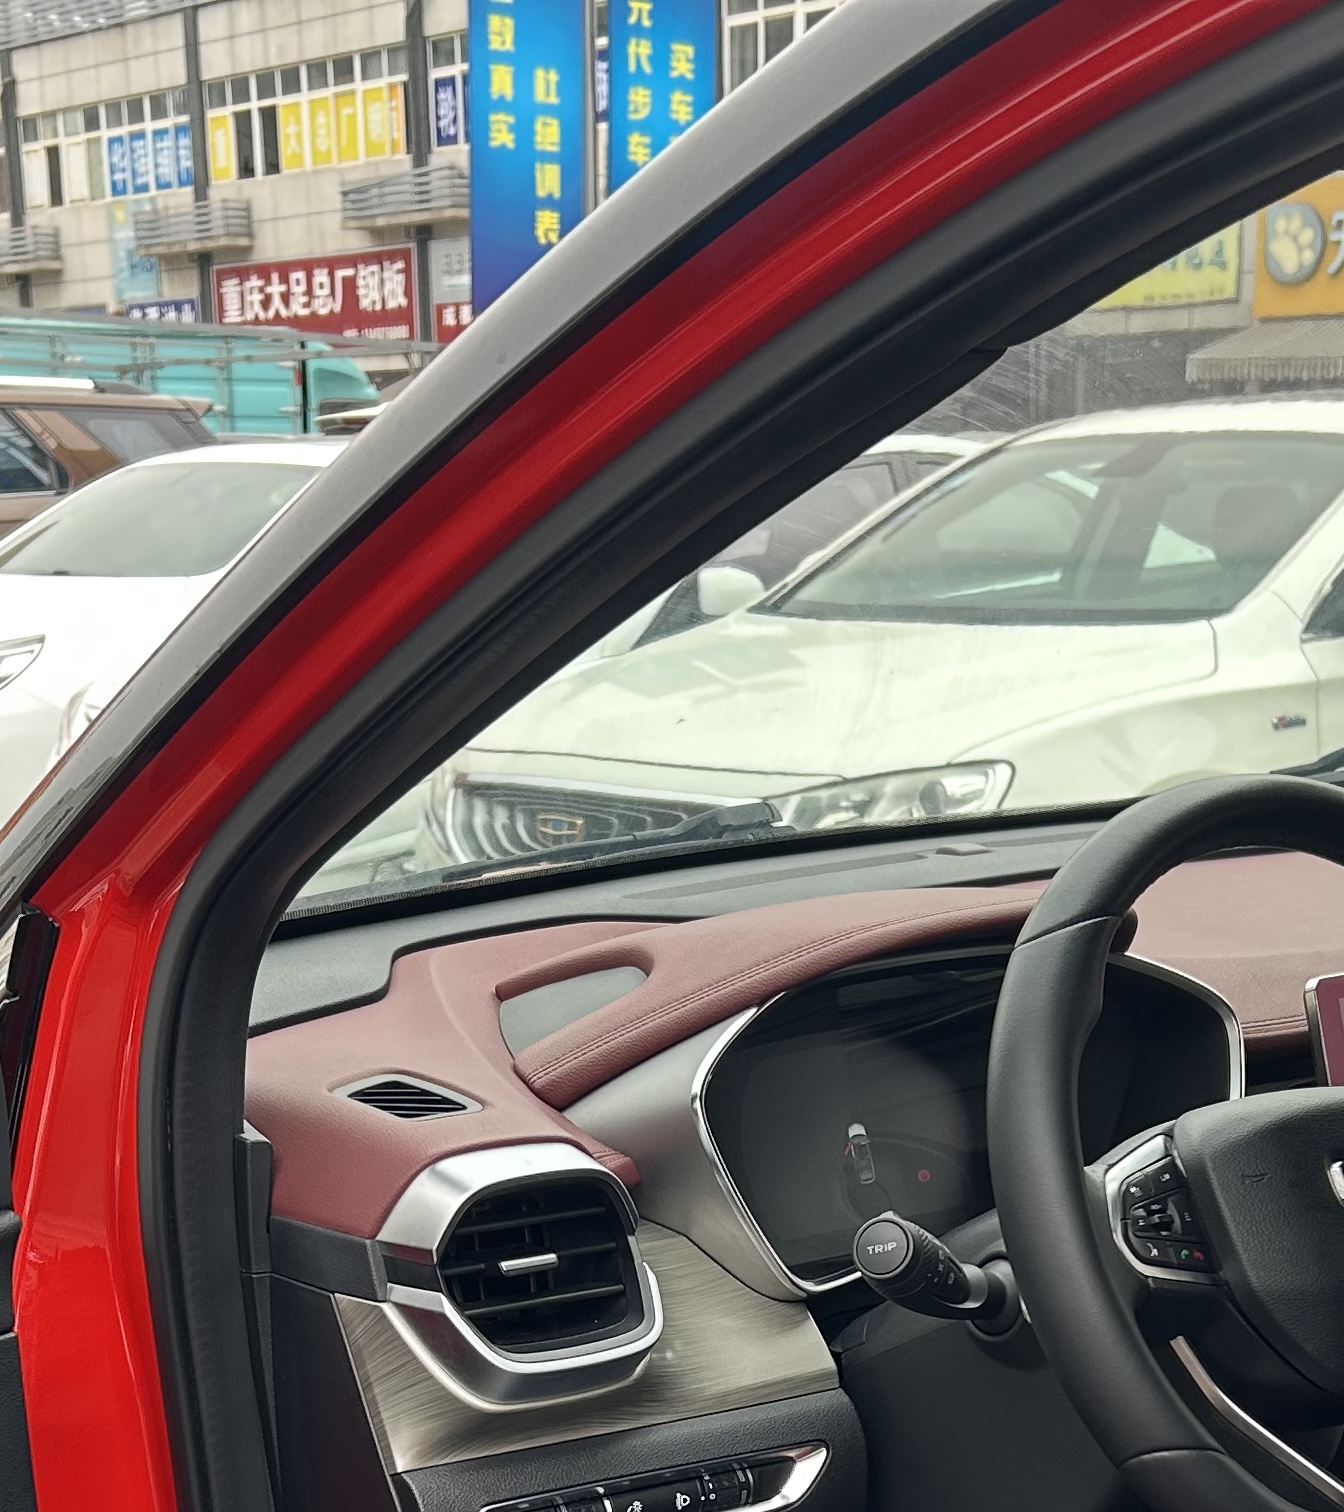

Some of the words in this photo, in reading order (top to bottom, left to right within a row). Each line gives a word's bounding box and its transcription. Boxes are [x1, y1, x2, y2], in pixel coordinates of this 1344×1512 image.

[487, 0, 515, 149] 数真实
[669, 43, 694, 144] 买车
[866, 1241, 897, 1255] TRIP
